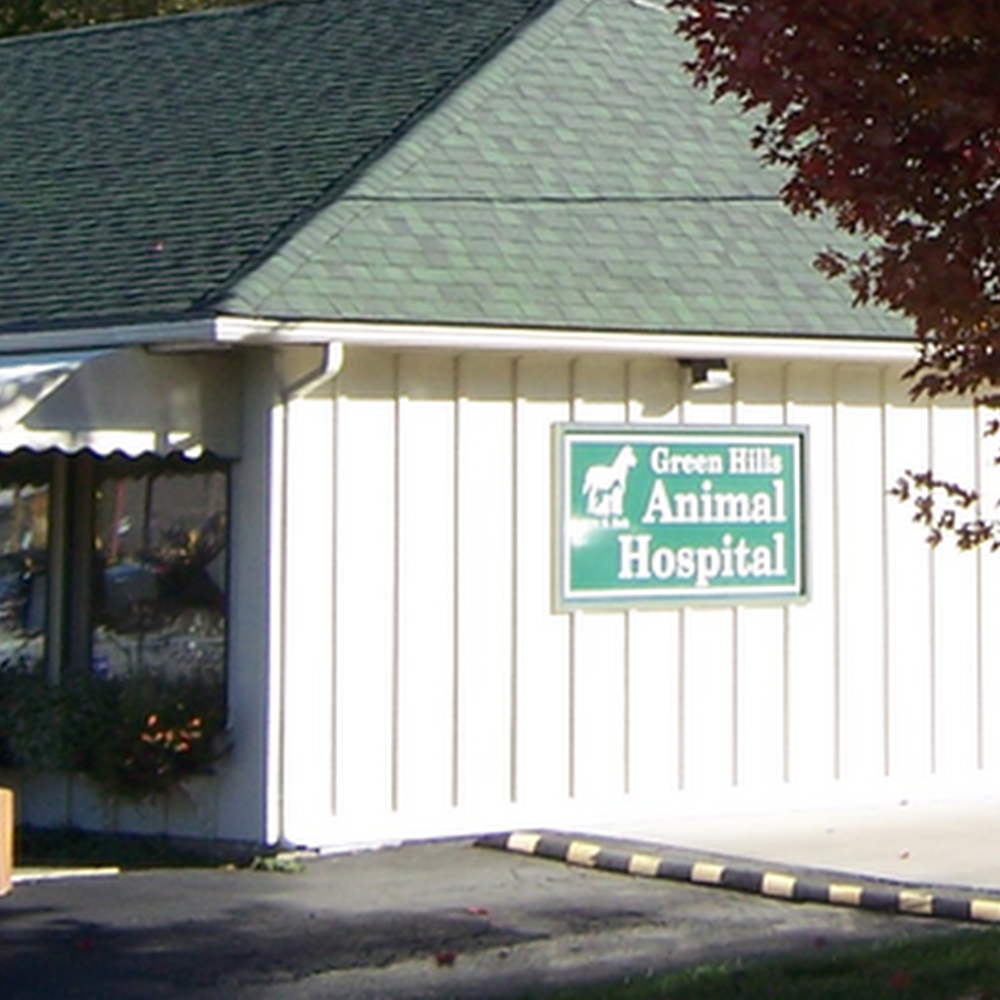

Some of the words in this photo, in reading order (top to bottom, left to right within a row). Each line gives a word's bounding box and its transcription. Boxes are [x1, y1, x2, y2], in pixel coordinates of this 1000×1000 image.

[650, 446, 723, 474] Green
[728, 447, 783, 475] Hills
[641, 478, 787, 524] Animal
[617, 532, 787, 587] Hospital
